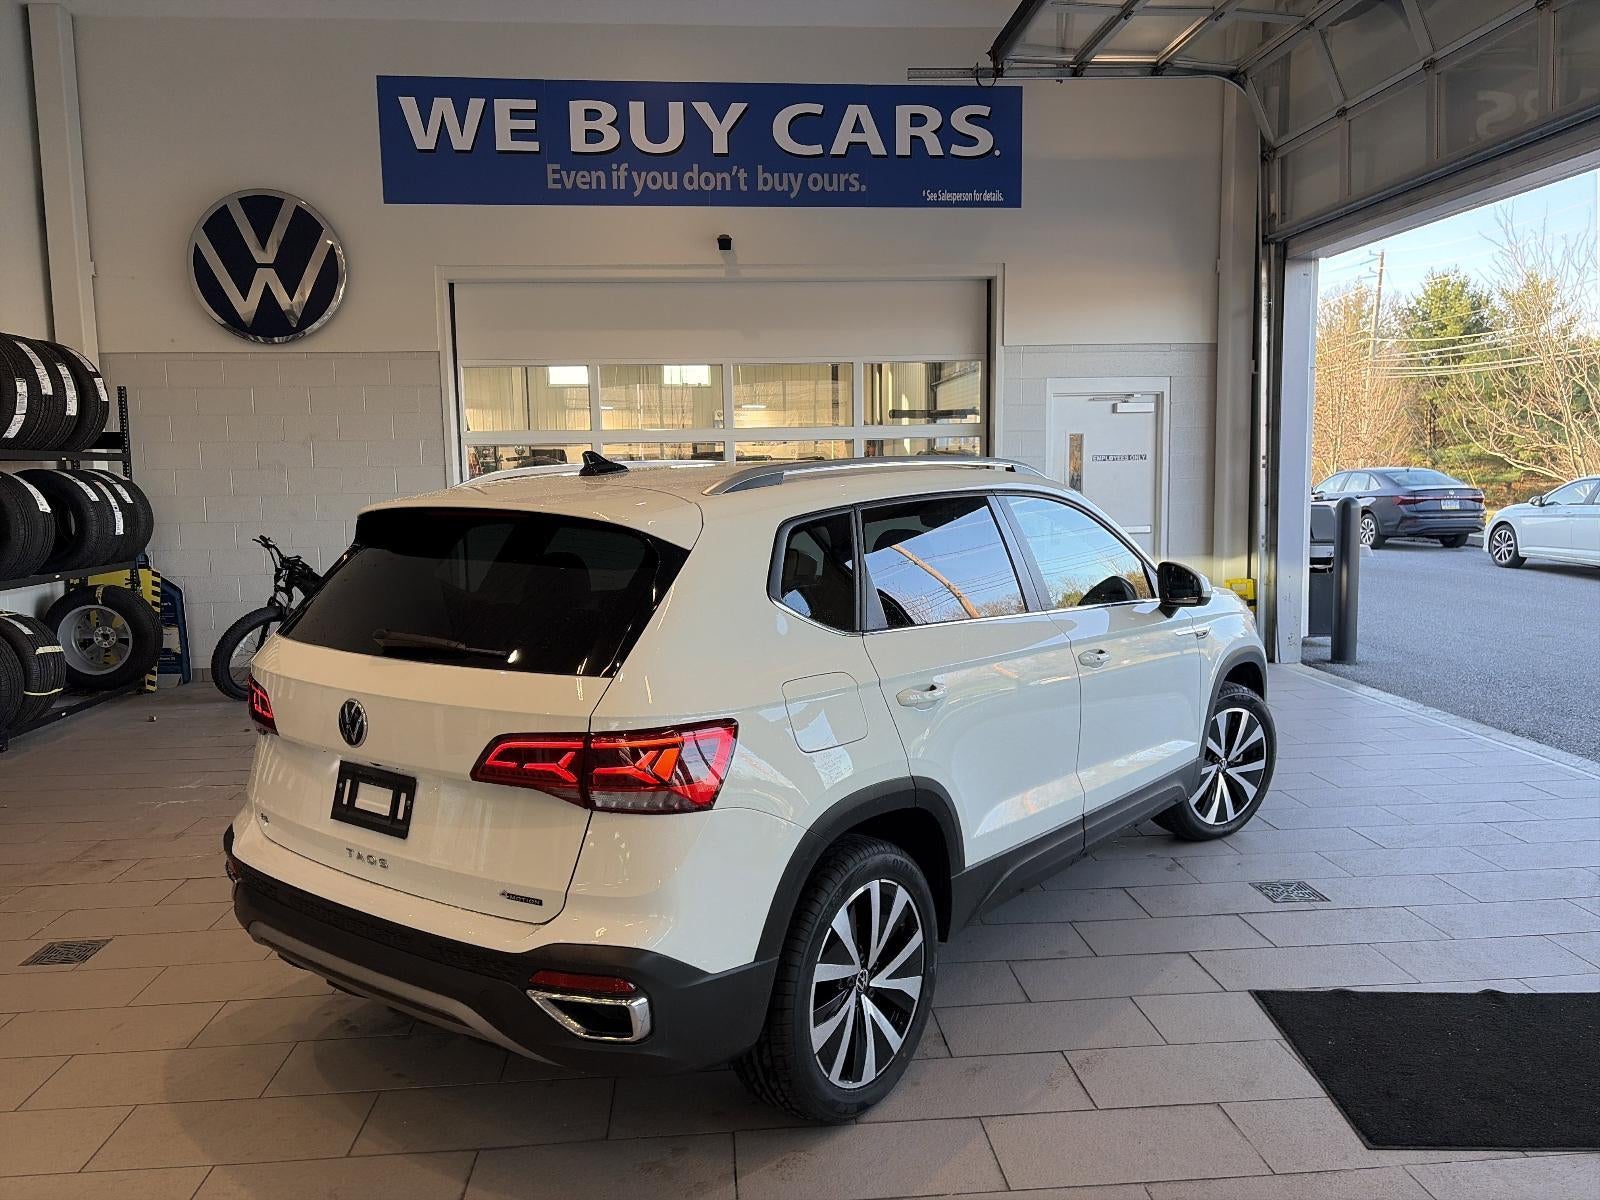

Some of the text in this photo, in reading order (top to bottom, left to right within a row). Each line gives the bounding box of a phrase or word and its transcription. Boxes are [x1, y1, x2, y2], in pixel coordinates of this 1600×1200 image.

[397, 96, 1001, 158] WE BUY CARS.
[546, 162, 867, 199] Even if you don't buy ours.
[938, 189, 973, 204] Salesperson
[973, 189, 983, 201] for
[983, 189, 1004, 202] details.
[1092, 454, 1129, 462] EMPLOYEES
[345, 847, 390, 869] TAOS
